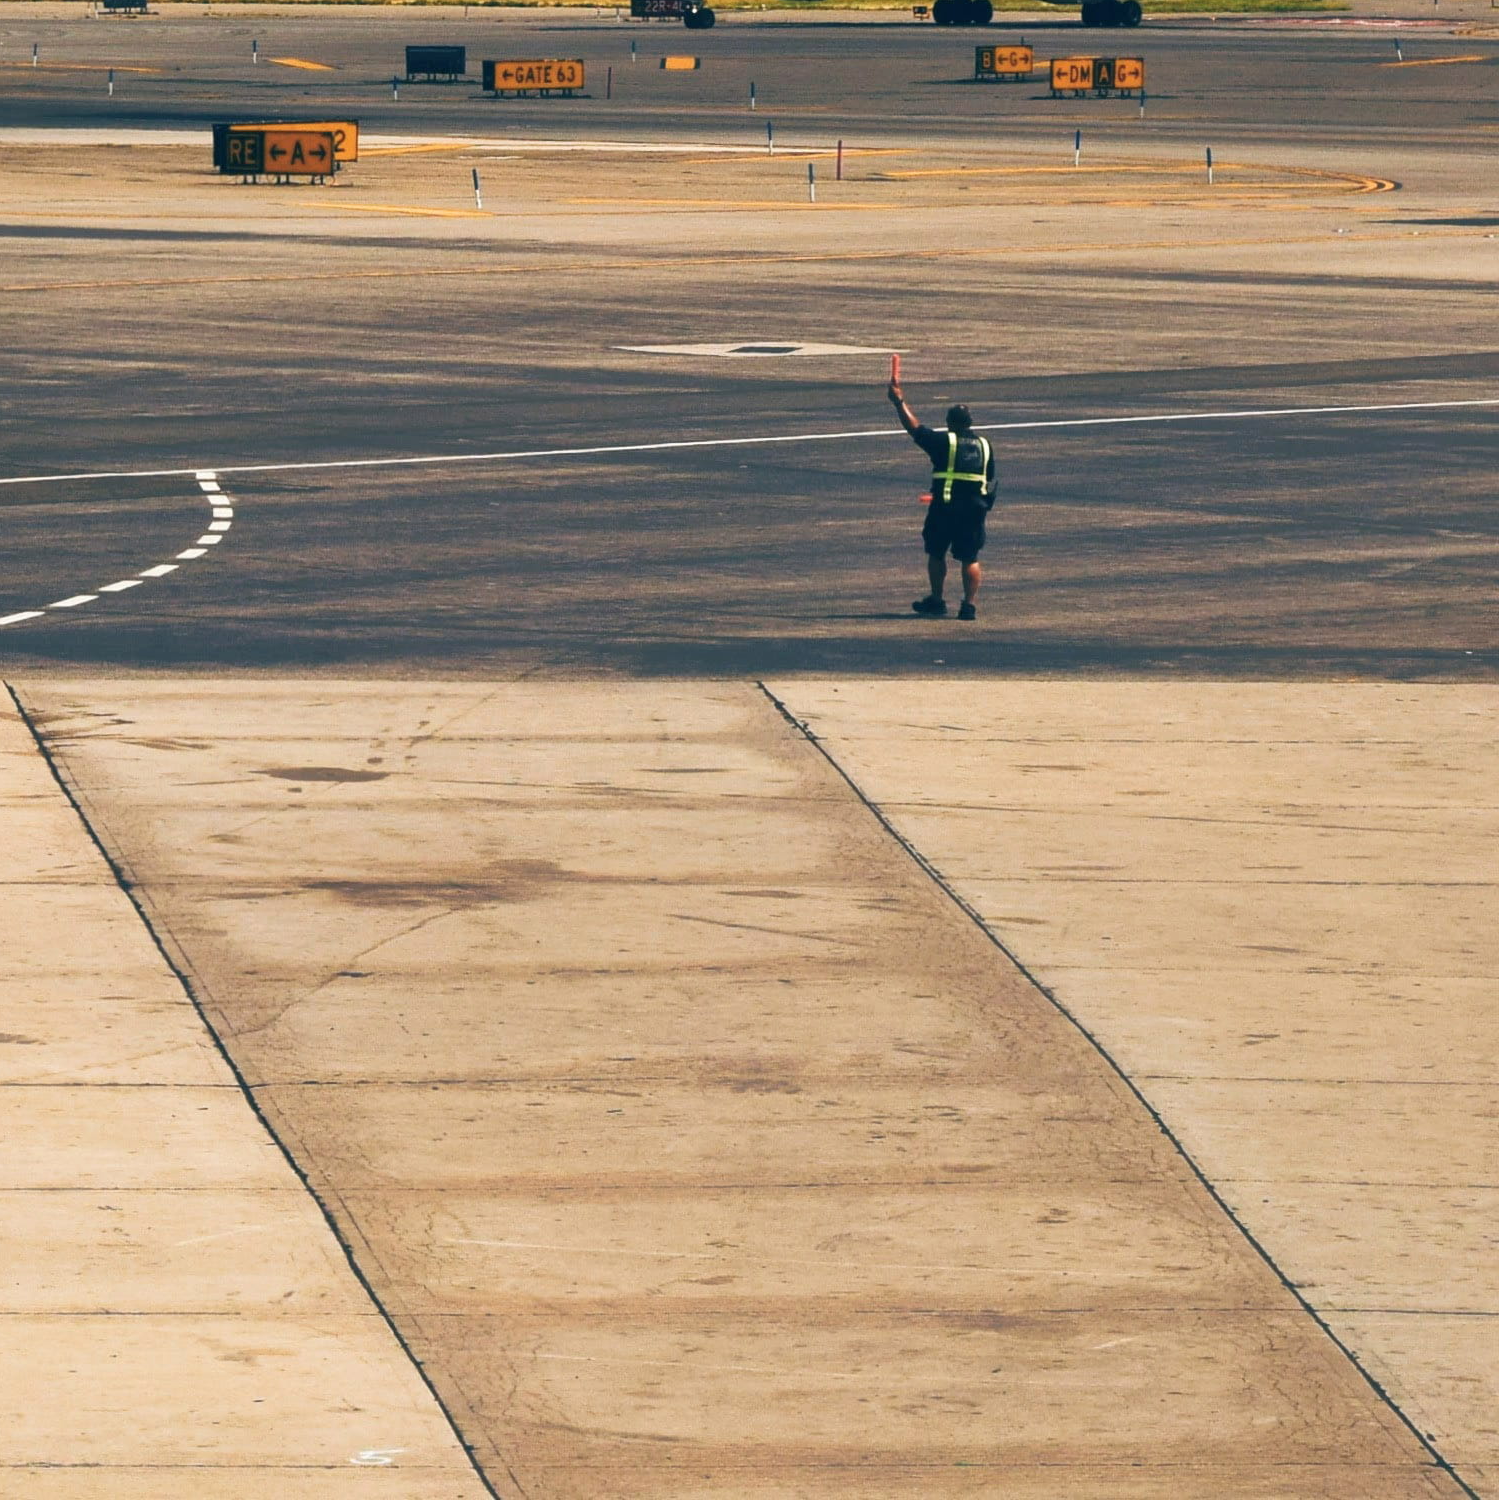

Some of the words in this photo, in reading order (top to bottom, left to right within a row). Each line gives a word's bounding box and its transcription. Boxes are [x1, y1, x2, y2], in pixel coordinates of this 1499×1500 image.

[1009, 52, 1017, 66] G
[515, 65, 552, 83] GATE
[556, 66, 576, 83] 63
[1070, 65, 1090, 82] DM
[1100, 66, 1108, 82] A
[1117, 65, 1126, 82] G
[229, 140, 256, 164] RE
[290, 140, 305, 165] A
